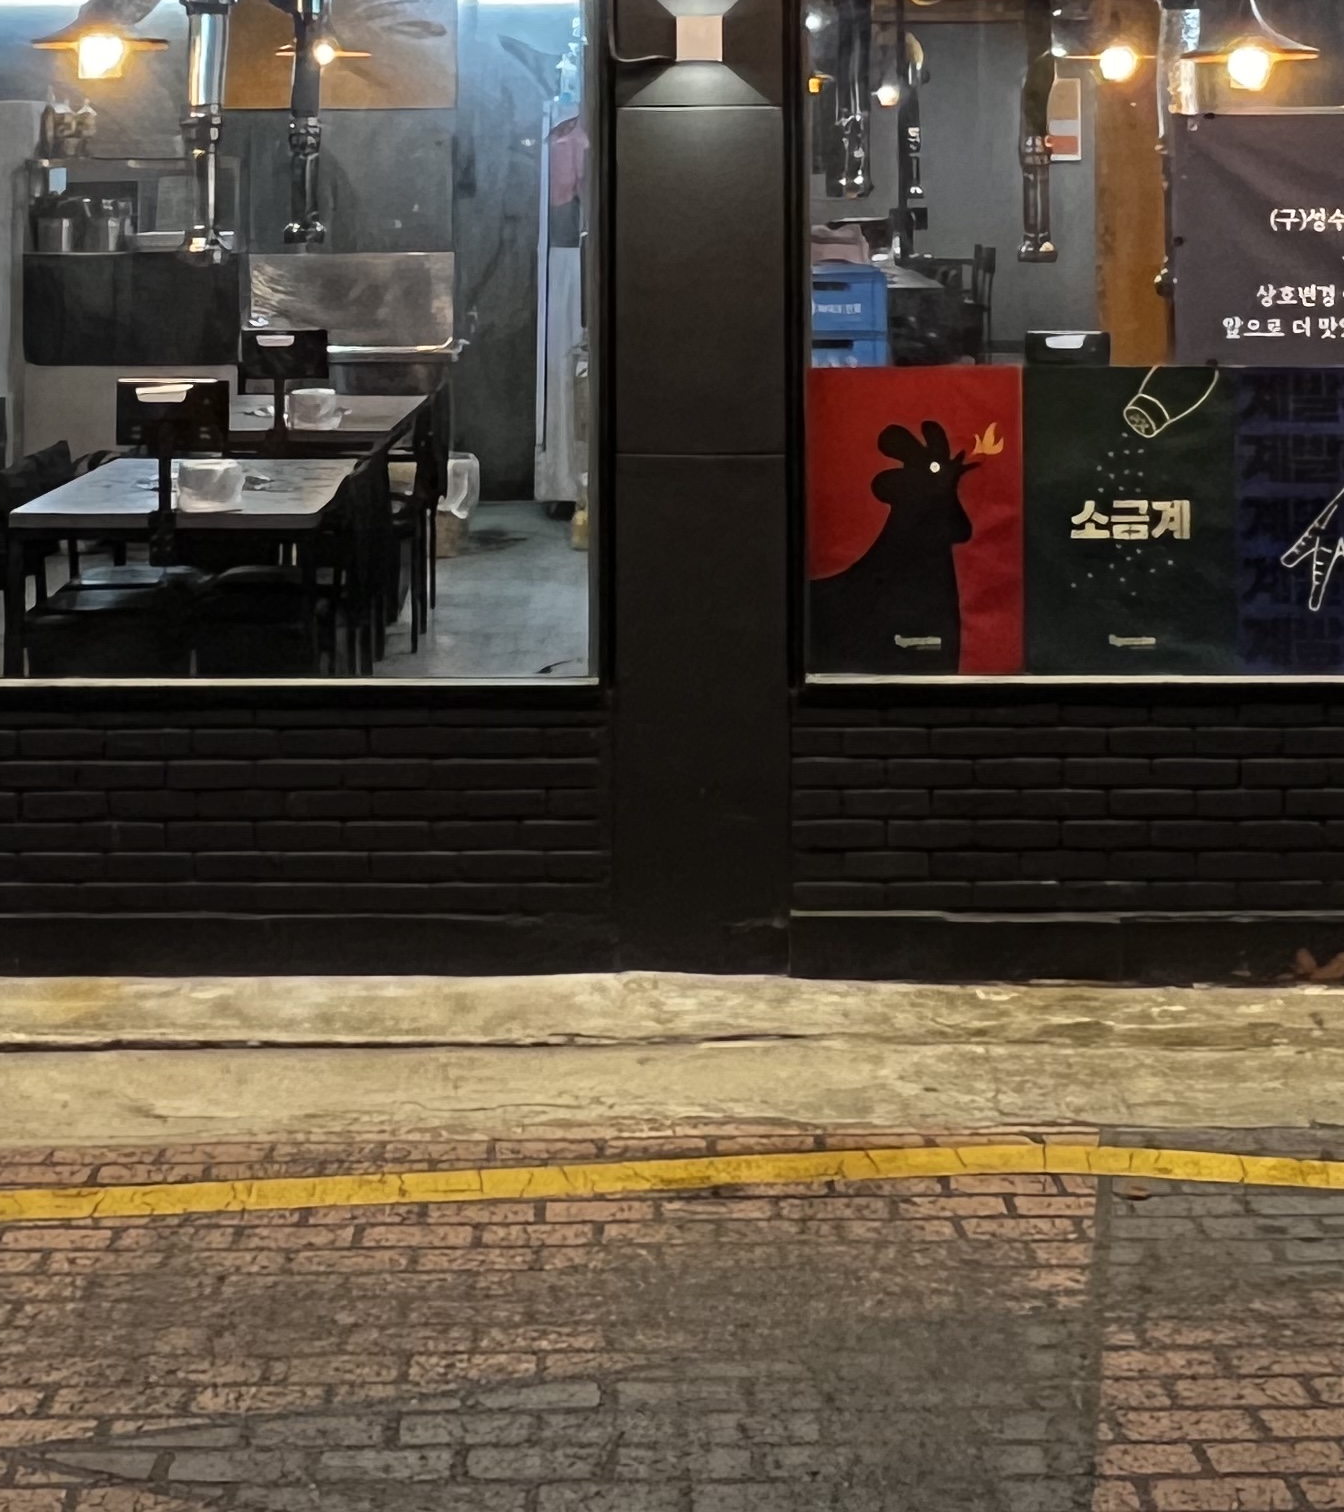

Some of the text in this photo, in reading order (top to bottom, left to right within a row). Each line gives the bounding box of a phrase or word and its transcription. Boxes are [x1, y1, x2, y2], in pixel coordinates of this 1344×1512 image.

[1256, 283, 1336, 307] 상호변경
[1222, 316, 1286, 339] 앞으로
[1292, 316, 1312, 337] 더
[1069, 498, 1192, 540] 소금계
